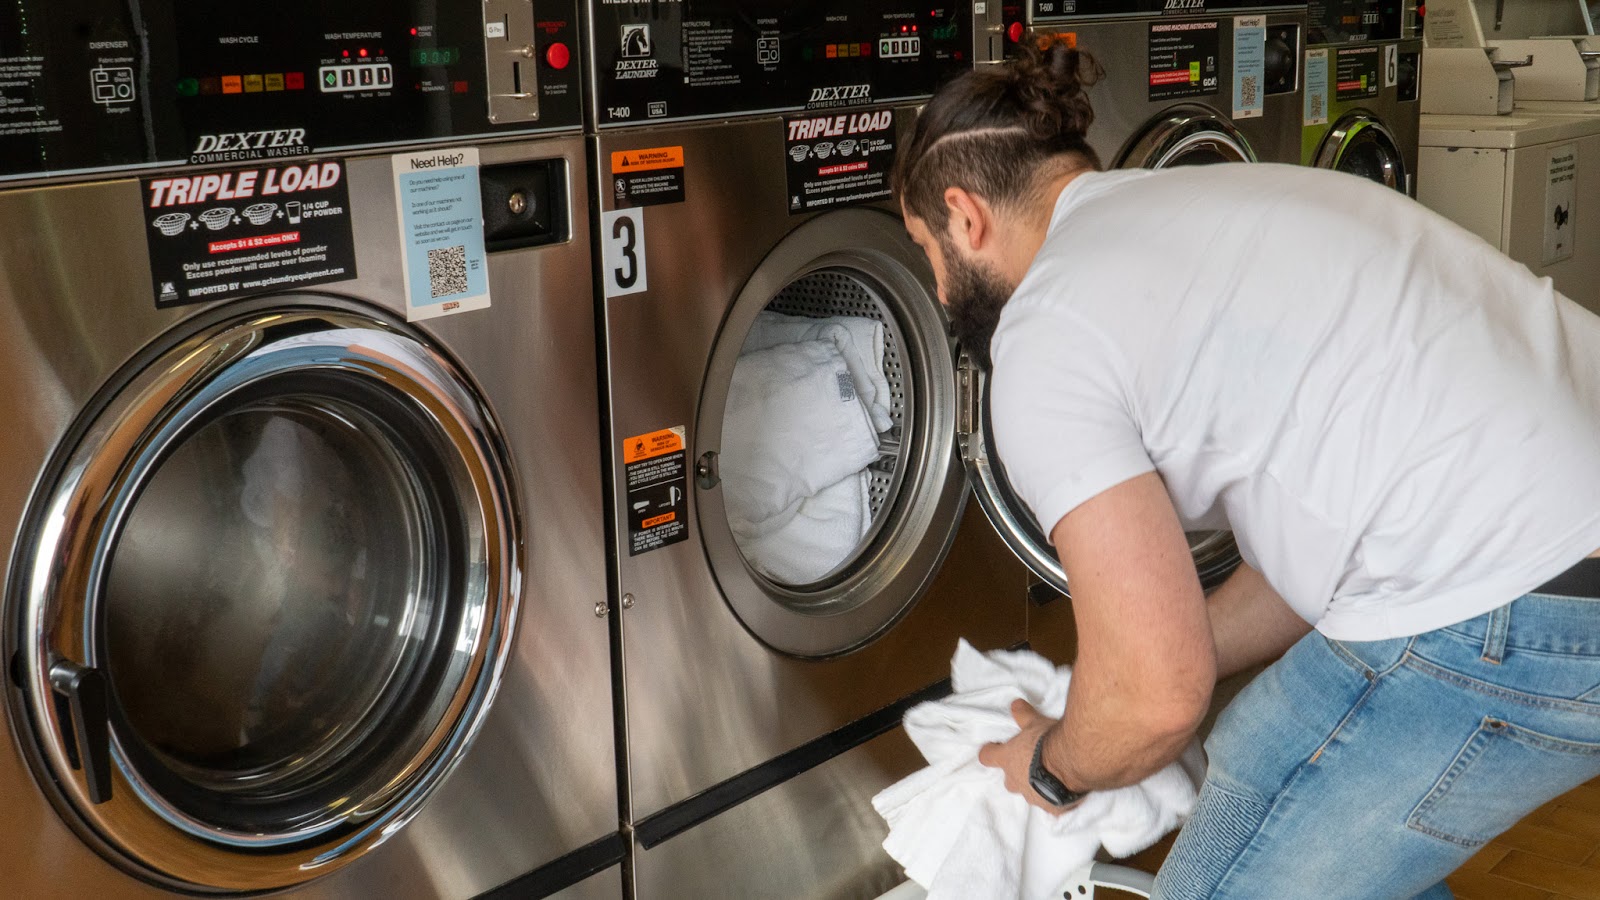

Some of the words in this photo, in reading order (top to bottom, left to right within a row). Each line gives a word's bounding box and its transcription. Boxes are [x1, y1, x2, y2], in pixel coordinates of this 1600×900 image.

[1039, 2, 1054, 12] T-600
[1164, 0, 1205, 9] DEXTER
[219, 36, 239, 44] WASH
[239, 35, 259, 43] CYCLE
[342, 31, 382, 39] TEMPERATURE
[89, 41, 128, 49] DISPENSER
[615, 58, 657, 71] DEXTER
[1388, 47, 1395, 83] 6
[615, 69, 659, 80] LAUNDRY
[809, 84, 870, 102] DEXTER
[807, 99, 846, 109] COMMERCIAL
[847, 96, 872, 105] WASHER
[607, 106, 630, 118] T-400
[788, 115, 847, 141] TRIPLE
[847, 110, 892, 134] LOAD
[193, 128, 306, 154] DEXTER
[190, 150, 263, 164] COMMERCIAL
[267, 145, 310, 157] WASHER
[411, 156, 436, 169] Need
[437, 153, 464, 168] Help?
[638, 152, 668, 160] WARNING
[150, 170, 258, 208] TRIPLE
[261, 162, 341, 196] LOAD
[302, 203, 315, 211] 1/4
[315, 200, 329, 209] CUP
[303, 211, 313, 219] OF
[313, 207, 343, 218] POWDER
[211, 241, 237, 252] Accepts
[238, 240, 247, 248] $1
[247, 239, 253, 247] &
[254, 238, 263, 246] $2
[264, 236, 281, 245] coins
[281, 233, 299, 242] ONLY
[183, 262, 200, 273] Only
[202, 261, 216, 270] use
[217, 253, 269, 267] recommended
[270, 249, 292, 259] levels
[293, 247, 301, 255] of
[301, 244, 328, 256] powder
[613, 215, 638, 289] 3
[186, 269, 213, 280] Excess
[215, 266, 242, 277] powder
[243, 262, 257, 271] will
[258, 260, 280, 269] cause
[281, 257, 297, 266] over
[298, 253, 326, 264] foaming
[188, 284, 228, 297] IMPORTED
[229, 282, 240, 290] BY
[242, 267, 345, 289] www.gclaundryequipment.com
[651, 432, 675, 443] WARNING
[645, 513, 673, 525] IMPORTANT
